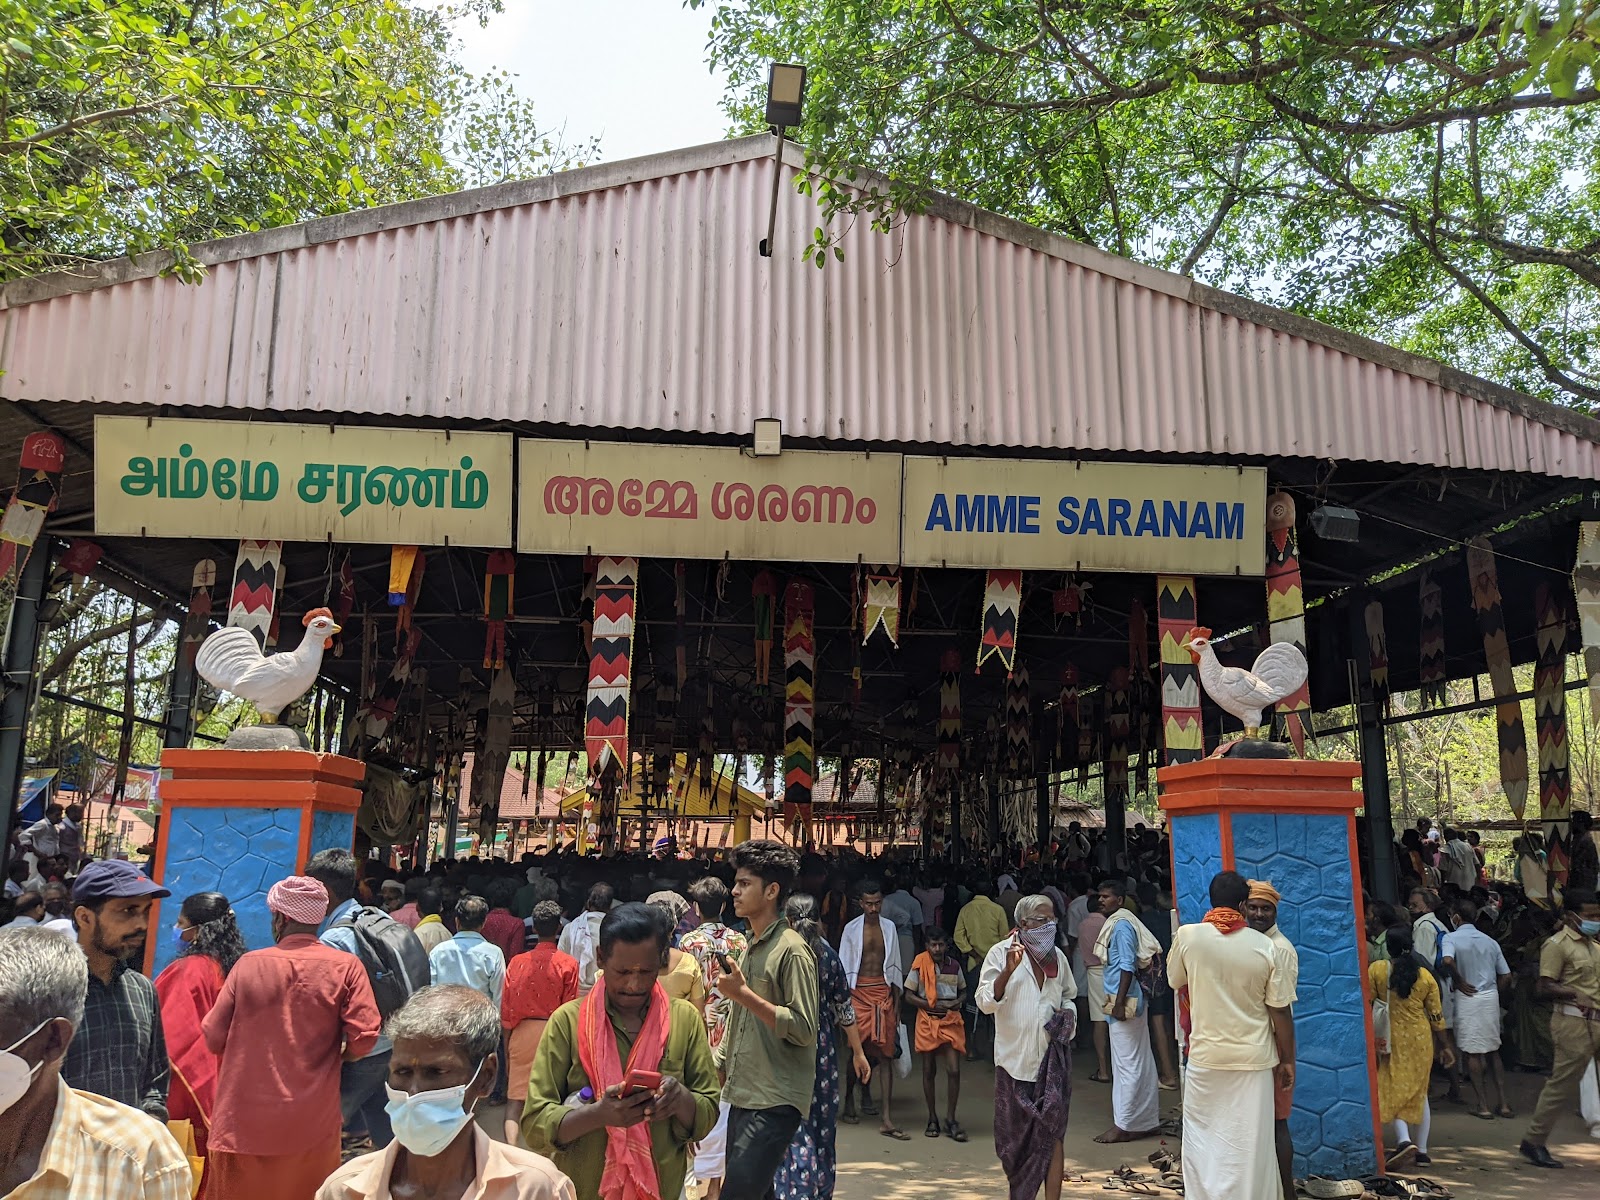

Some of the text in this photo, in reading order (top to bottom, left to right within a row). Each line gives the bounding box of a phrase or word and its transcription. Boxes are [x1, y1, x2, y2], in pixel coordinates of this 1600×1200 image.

[121, 444, 488, 515] அம்மே சரணம்
[544, 476, 876, 524] അമ്മേ ശരണം
[925, 493, 1244, 540] AMME SARANAM
